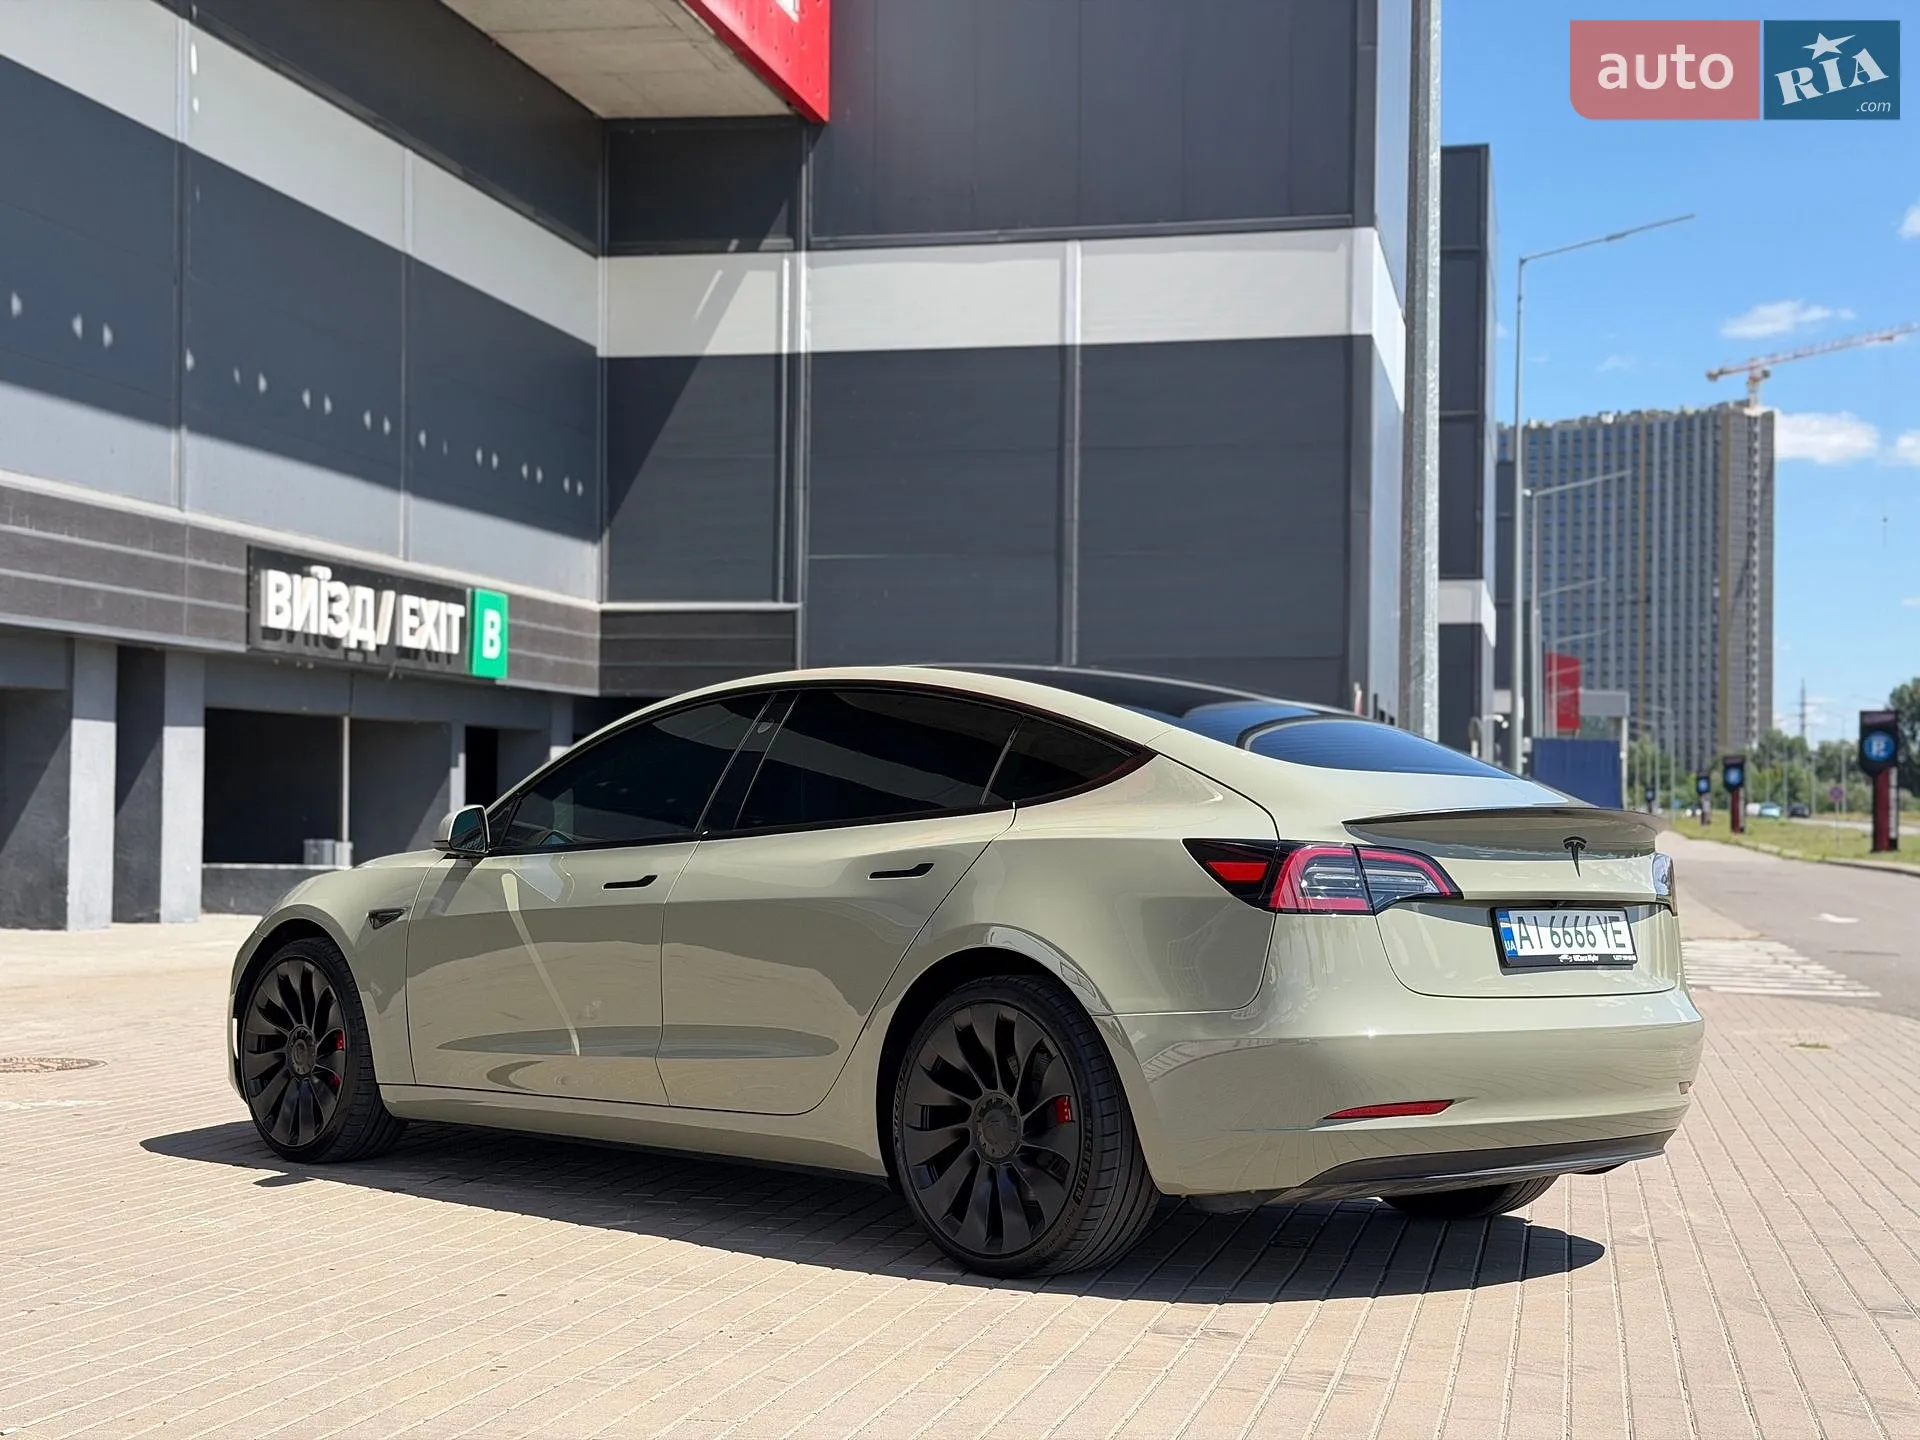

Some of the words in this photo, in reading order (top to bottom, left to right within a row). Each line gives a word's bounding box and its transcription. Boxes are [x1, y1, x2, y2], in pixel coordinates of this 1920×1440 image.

[397, 594, 466, 654] EXIT
[1504, 939, 1517, 951] UA
[1517, 915, 1544, 950] AI
[1549, 915, 1597, 949] 6666
[1597, 915, 1626, 949] YE
